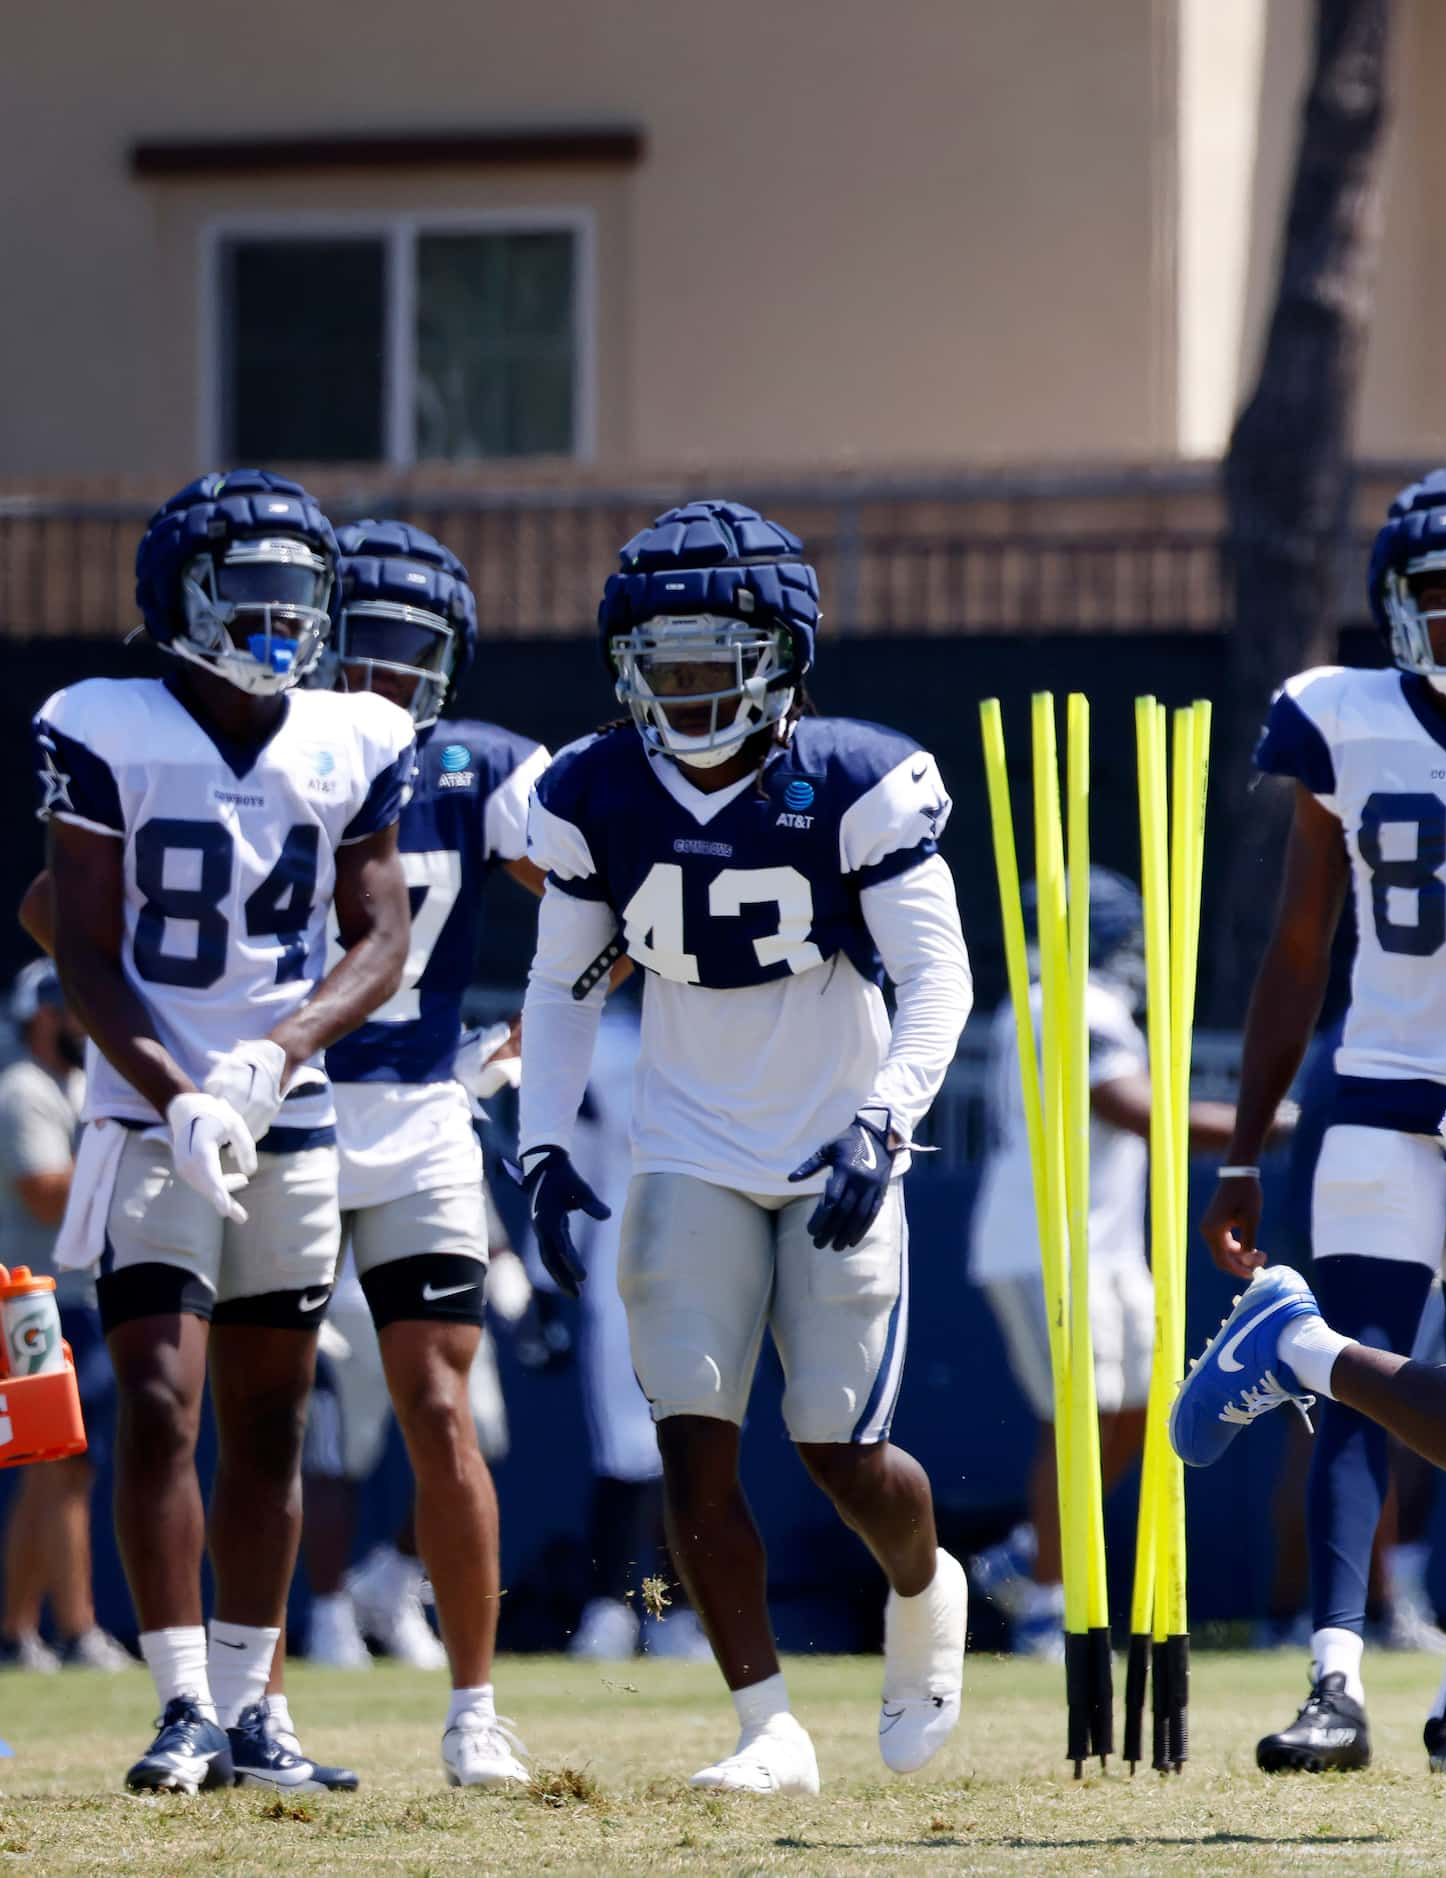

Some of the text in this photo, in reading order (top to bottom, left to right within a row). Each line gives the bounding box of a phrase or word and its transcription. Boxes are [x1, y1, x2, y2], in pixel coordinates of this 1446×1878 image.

[775, 812, 815, 830] AT&T
[133, 816, 320, 990] 84
[622, 862, 825, 984] 43
[12, 1315, 52, 1362] G
